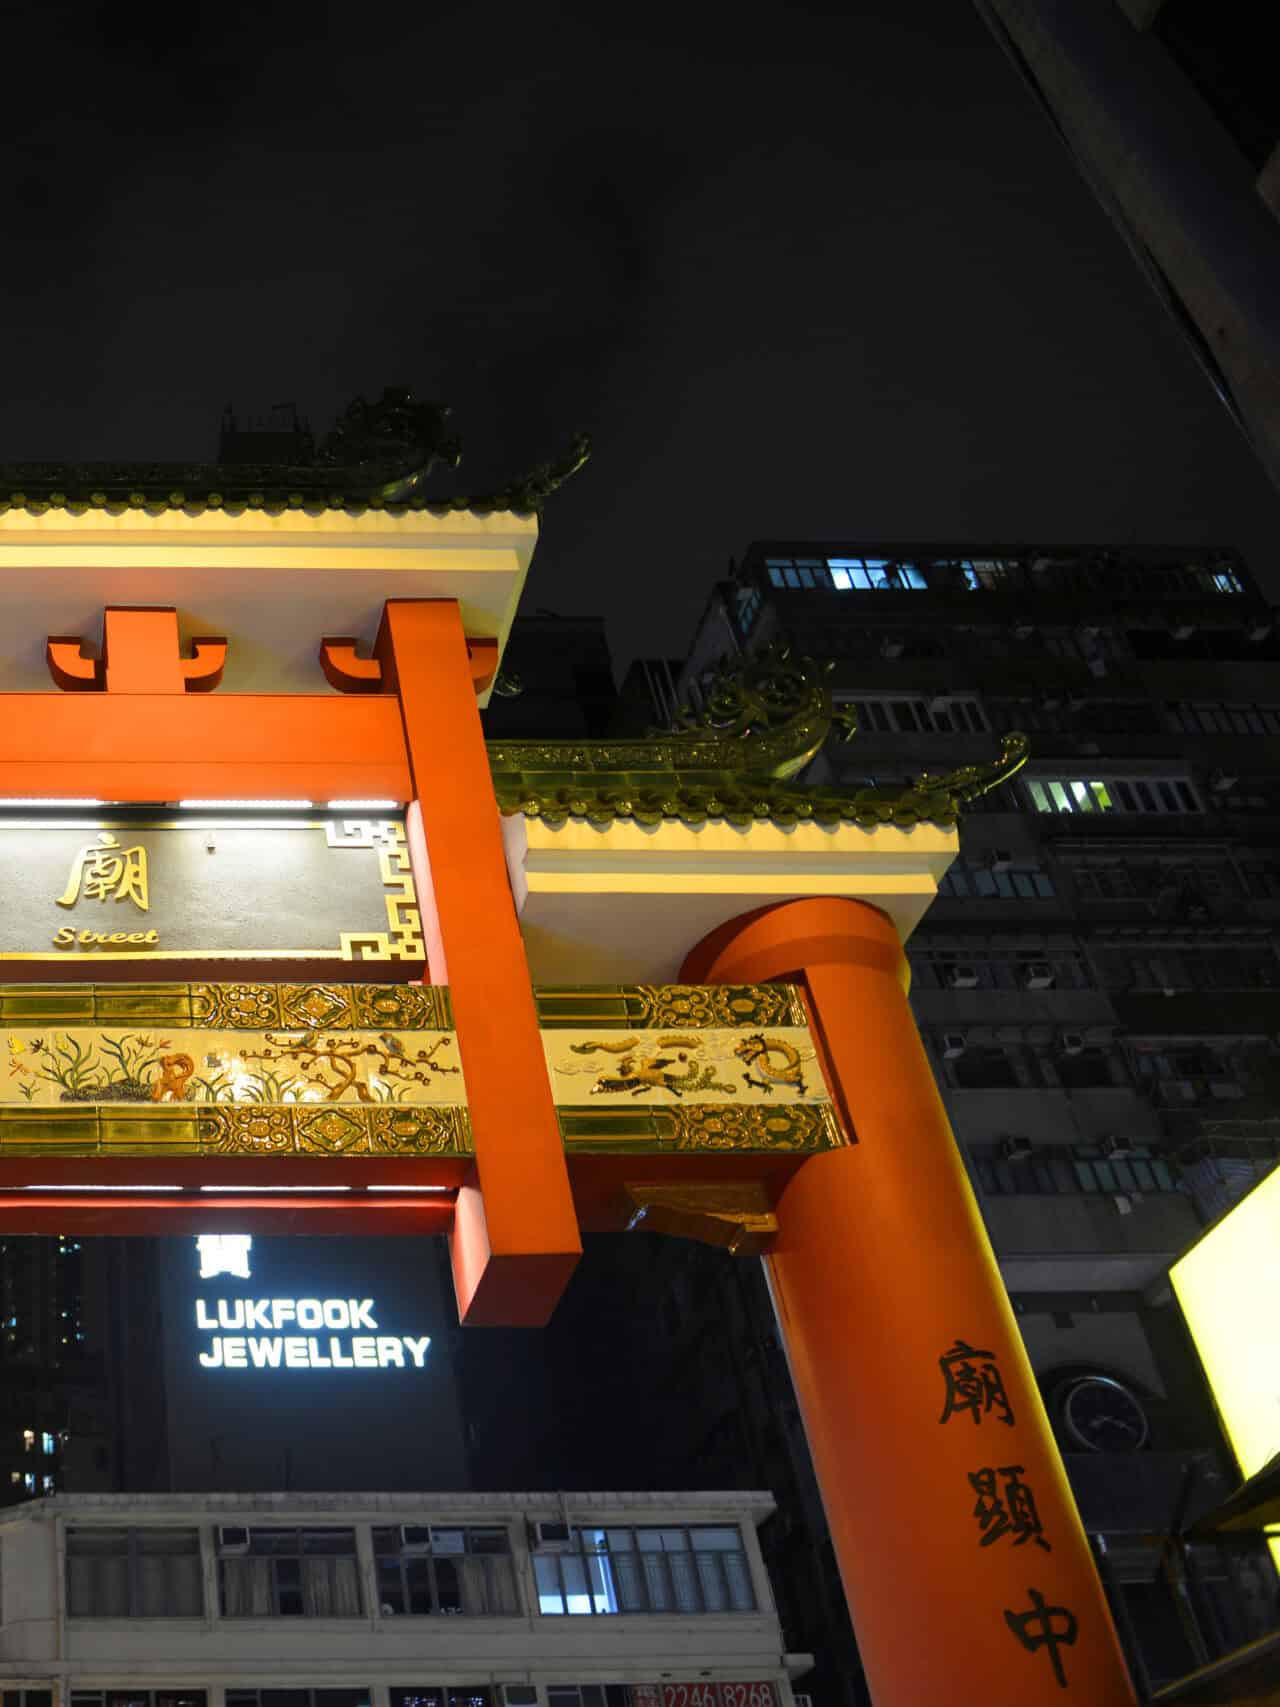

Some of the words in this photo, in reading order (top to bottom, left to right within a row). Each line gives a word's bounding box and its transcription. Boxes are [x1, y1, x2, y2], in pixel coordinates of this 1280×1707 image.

[52, 926, 160, 946] Street
[195, 1299, 379, 1330] LUKFOOK
[198, 1337, 432, 1368] JEWELLERY
